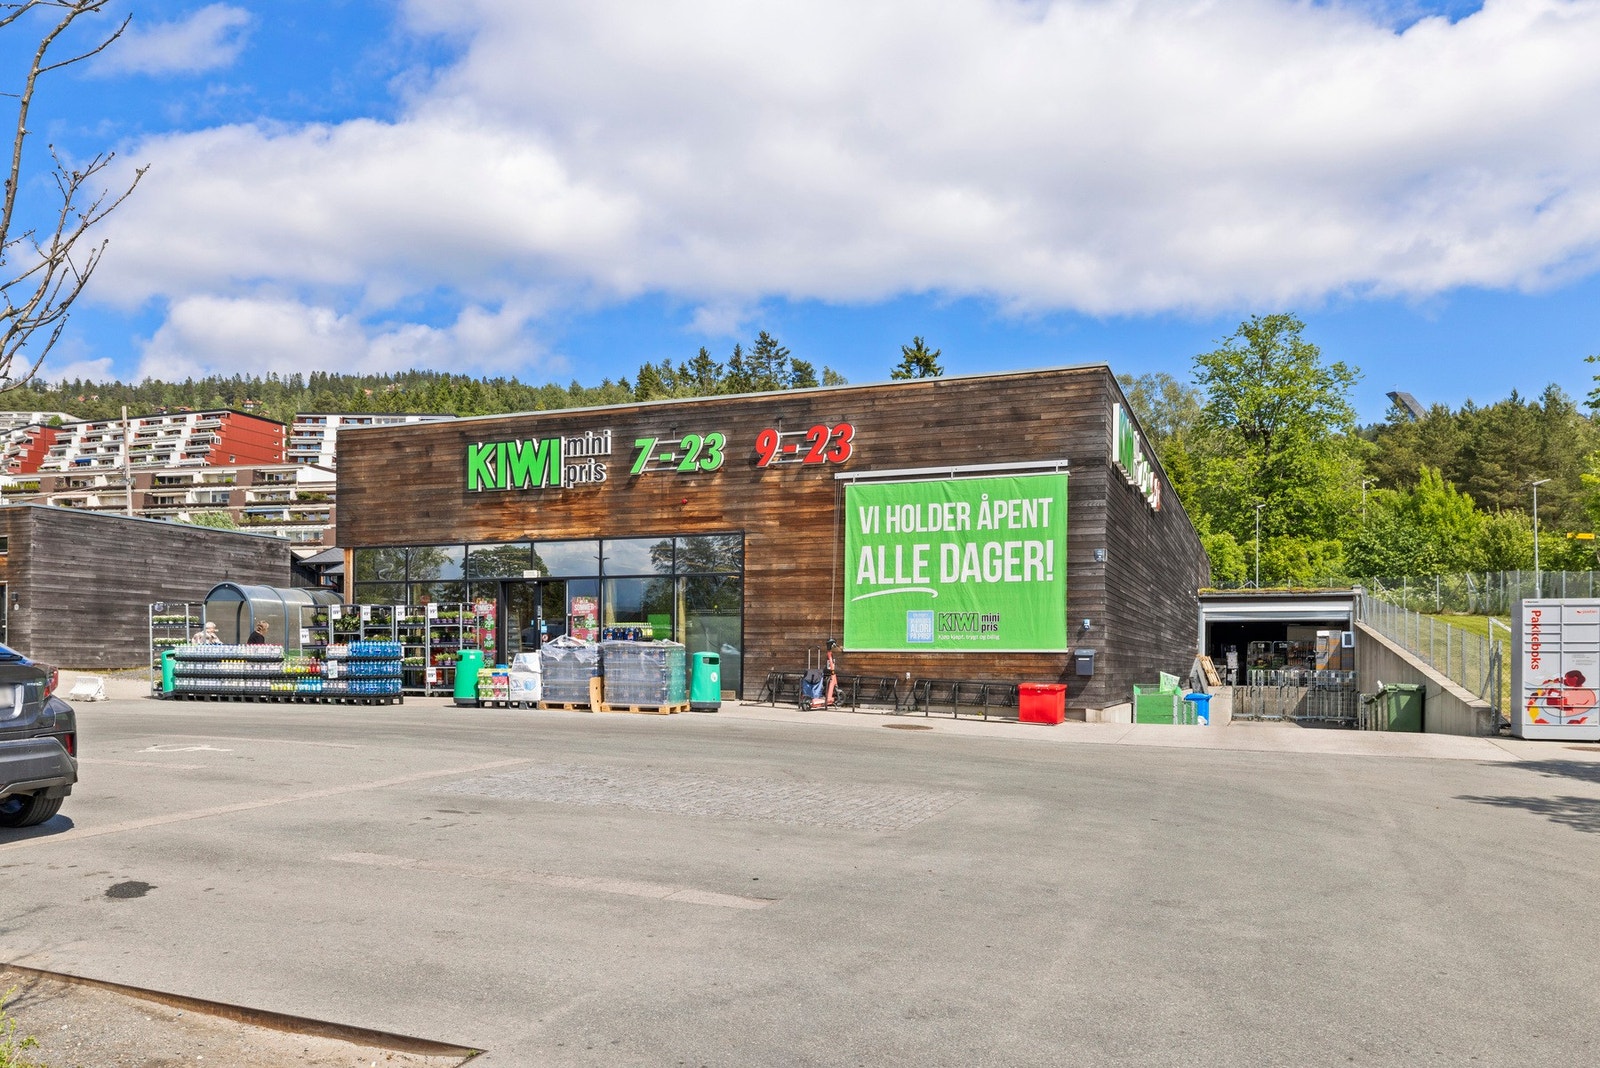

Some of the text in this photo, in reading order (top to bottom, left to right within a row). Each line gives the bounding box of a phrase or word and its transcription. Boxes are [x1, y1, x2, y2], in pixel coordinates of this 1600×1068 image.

[467, 429, 612, 491] KIWI mini
[566, 458, 607, 489] pris
[859, 493, 1053, 534] VI HOLDER ÅPENT
[856, 540, 1054, 584] ALLE DAGER!
[938, 612, 1000, 632] KIWI mini
[981, 622, 998, 633] pris
[1531, 610, 1541, 670] Pakkeboks
